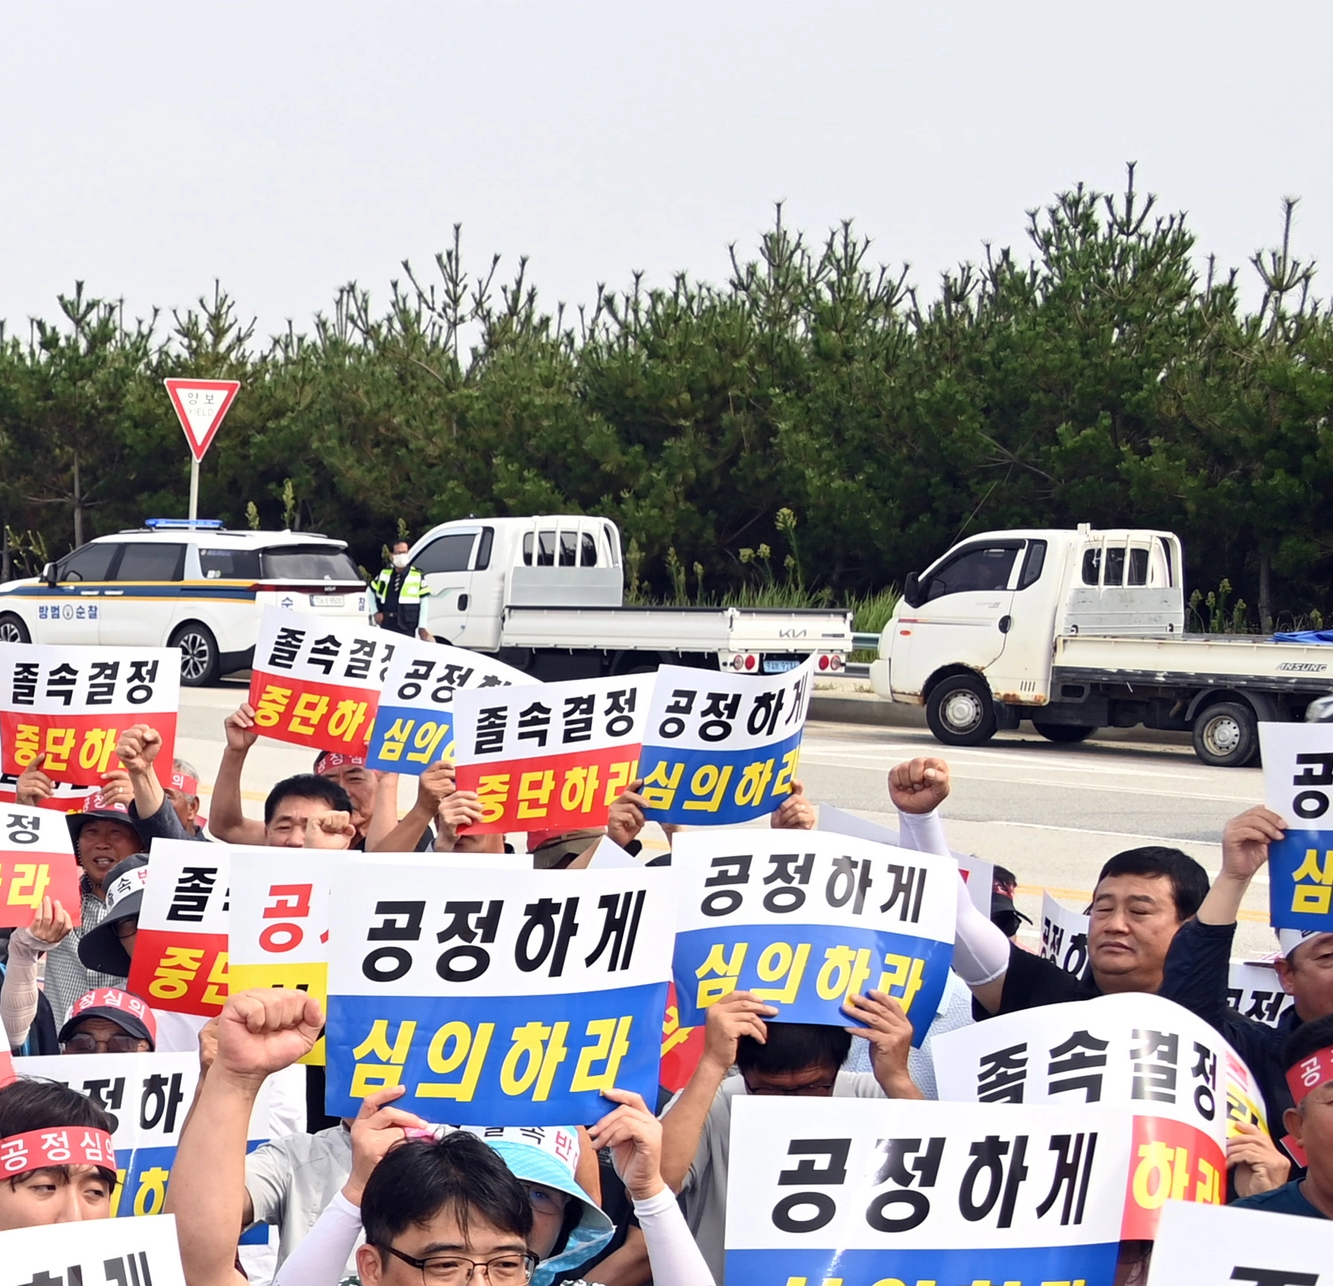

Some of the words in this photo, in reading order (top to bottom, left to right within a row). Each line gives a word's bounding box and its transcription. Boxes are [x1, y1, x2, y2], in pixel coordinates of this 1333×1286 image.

[188, 408, 214, 417] YIELD
[38, 605, 60, 619] 방범
[75, 604, 98, 619] 순찰
[11, 659, 160, 707] 졸속결정
[253, 683, 371, 743] 중단하
[658, 672, 810, 743] 공정하게
[13, 722, 125, 774] 중단하
[378, 717, 456, 765] 심의
[473, 686, 638, 756] 졸속결정
[700, 852, 927, 924] 공정하게
[361, 888, 648, 983] 공정하게
[78, 989, 146, 1020] 정심의
[695, 940, 926, 1012] 심의하라
[348, 1015, 634, 1102] 심의하라
[770, 1130, 1099, 1234] 공정하게
[1131, 1139, 1224, 1211] 하라
